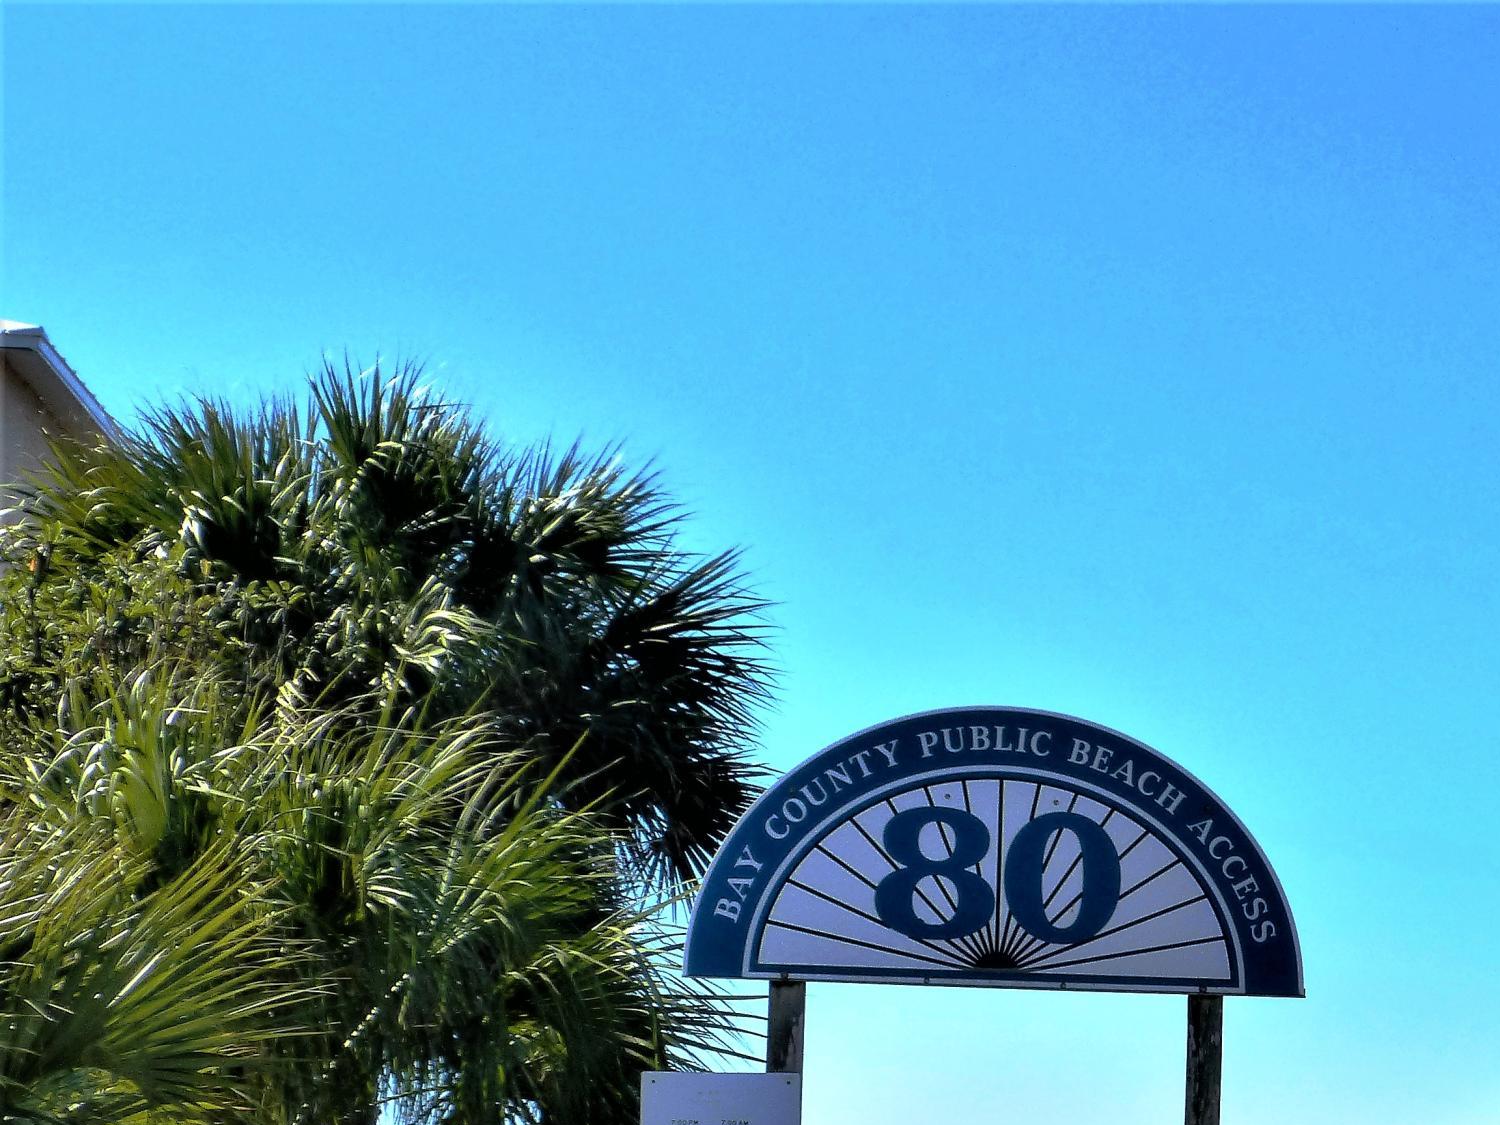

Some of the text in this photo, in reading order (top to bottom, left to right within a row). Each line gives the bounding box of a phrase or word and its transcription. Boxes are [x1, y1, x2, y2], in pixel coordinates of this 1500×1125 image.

[713, 725, 1277, 944] BAY COUNTY PUBLIC BEACH ACCESS
[873, 806, 1122, 945] 80
